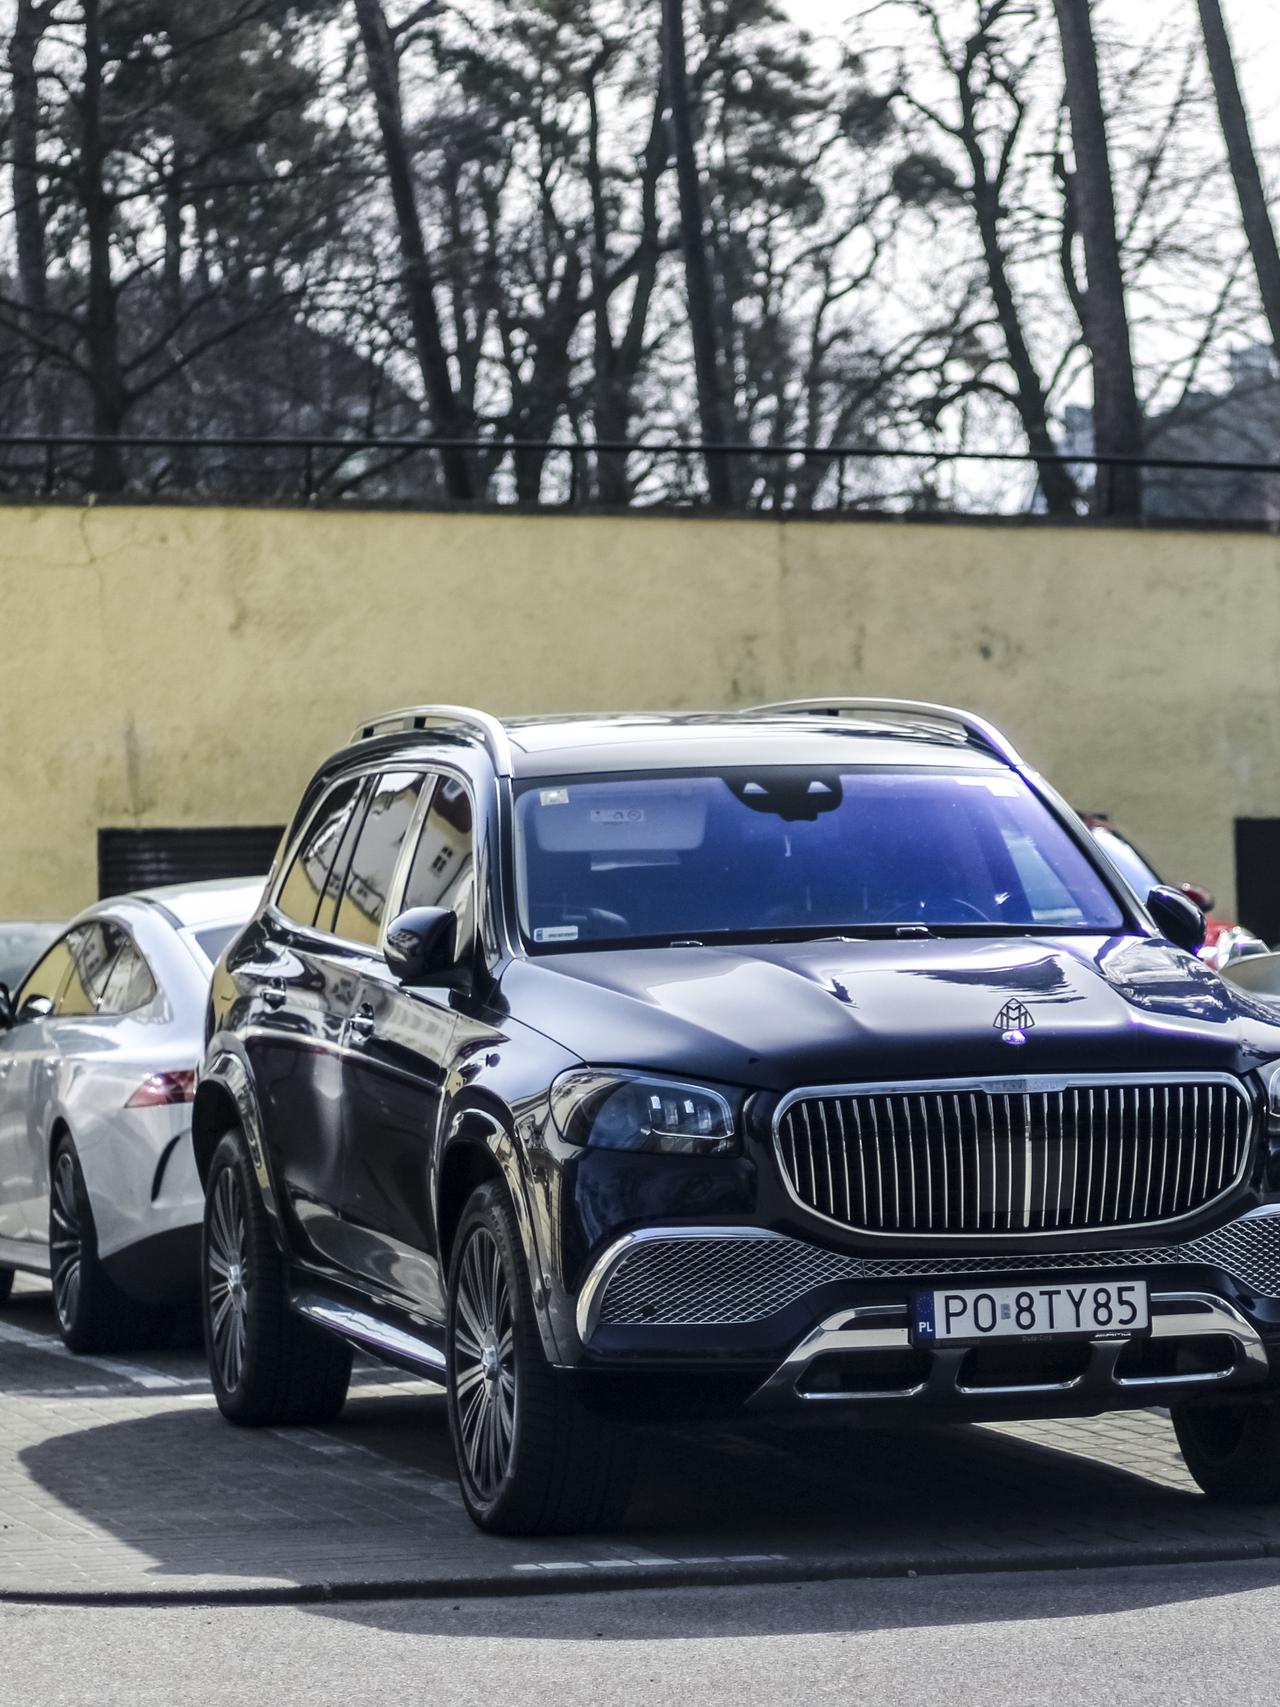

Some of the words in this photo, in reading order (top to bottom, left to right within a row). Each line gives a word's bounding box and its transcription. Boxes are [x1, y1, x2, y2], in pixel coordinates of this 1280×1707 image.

[944, 1293, 997, 1335] PO
[1014, 1286, 1138, 1331] 8TY85
[918, 1322, 933, 1333] PL
